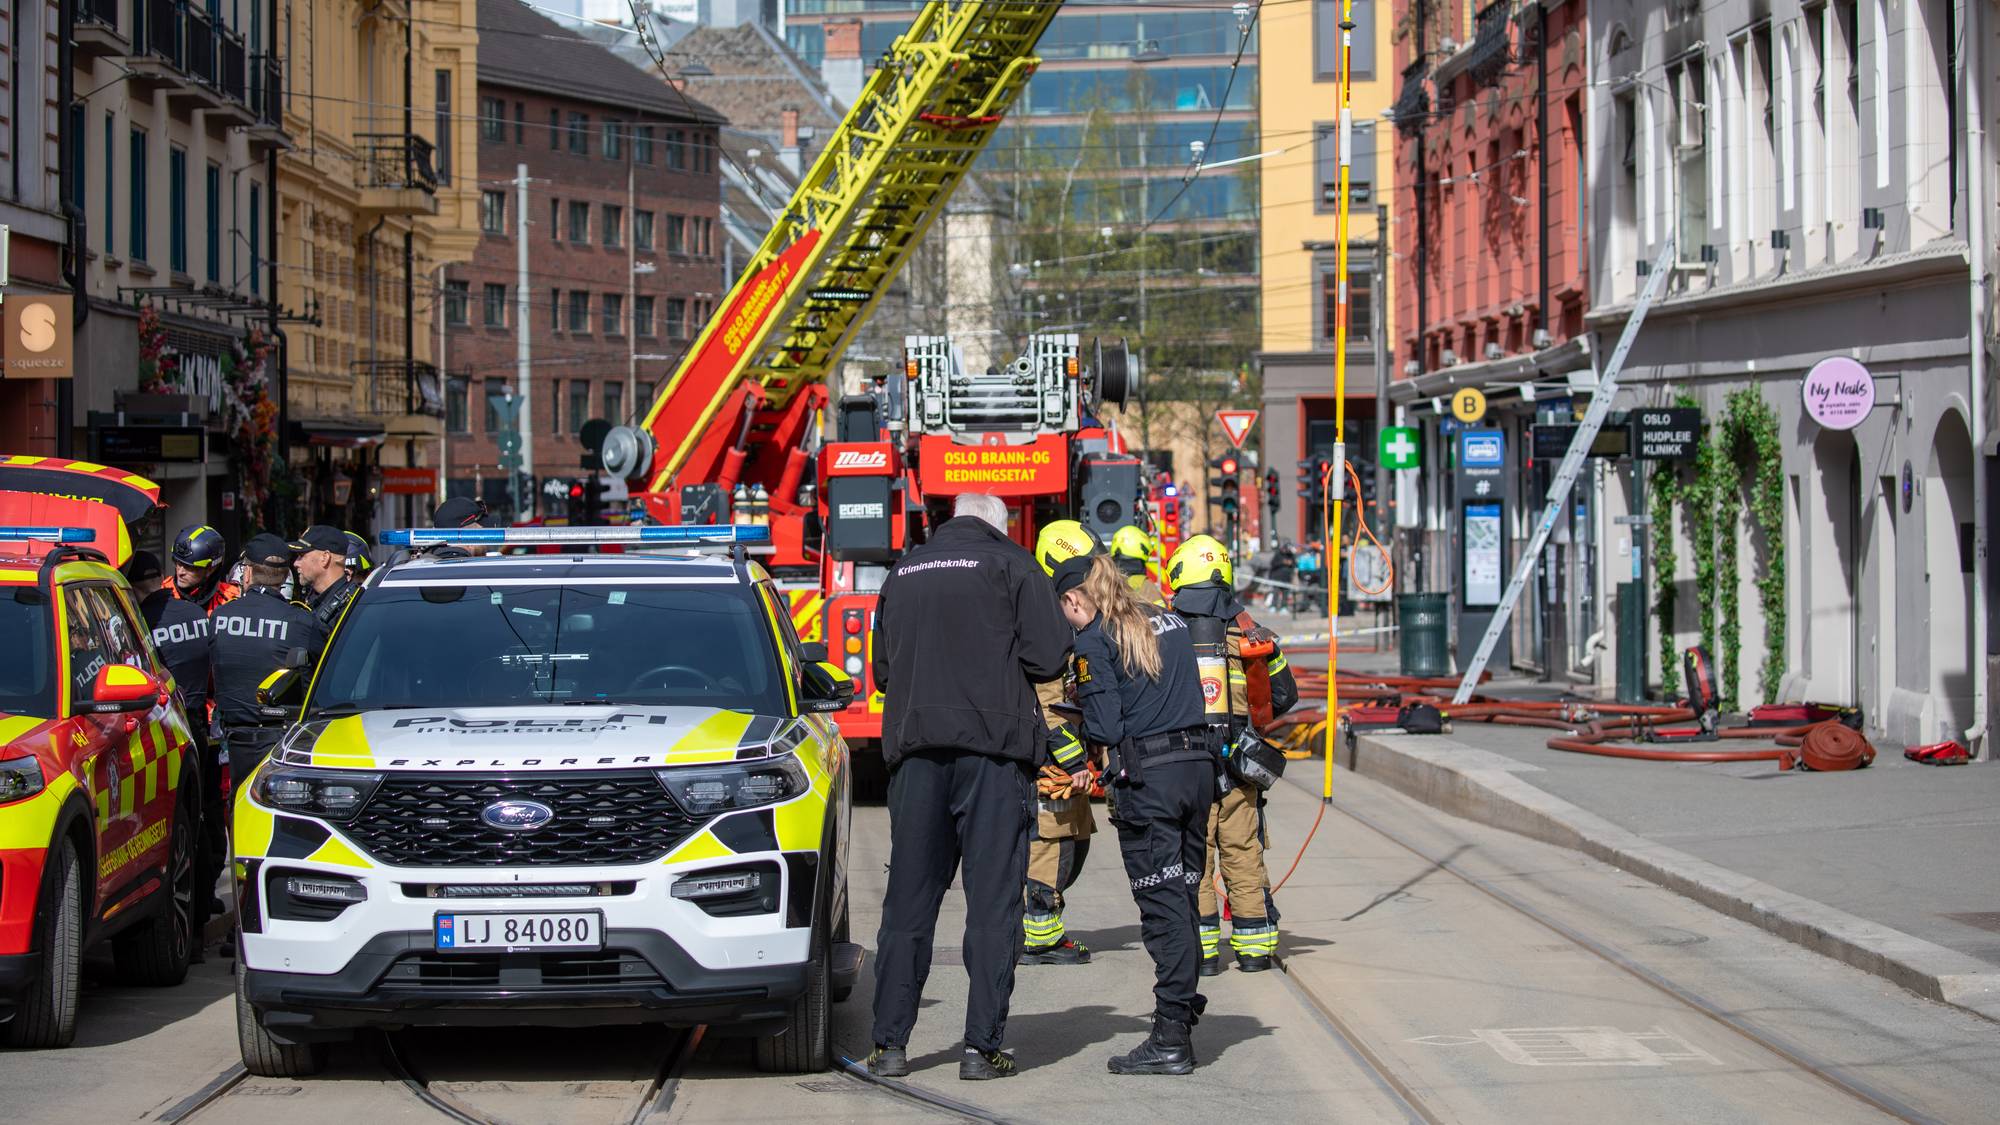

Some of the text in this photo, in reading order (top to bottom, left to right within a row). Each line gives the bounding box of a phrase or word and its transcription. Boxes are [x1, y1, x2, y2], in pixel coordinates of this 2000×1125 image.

[728, 261, 790, 355] OG REDNINGSETAT
[723, 315, 744, 347] OSLO
[11, 358, 65, 369] squeeze
[1810, 380, 1868, 402] Ny Nails
[1463, 396, 1477, 414] B
[1643, 413, 1671, 426] OSLO
[1643, 431, 1692, 443] HUDPLEIE
[1643, 444, 1682, 455] KLINIKK
[835, 451, 887, 467] Metz
[944, 452, 977, 465] OSLO
[944, 469, 1037, 482] REDNINGSETAT
[1055, 538, 1080, 557] OBRE
[897, 559, 979, 577] Kriminaltekniker
[214, 615, 288, 641] POLITI
[1148, 613, 1188, 636] OLITI
[152, 618, 210, 648] POLIT
[1078, 674, 1092, 683] OLITI
[393, 713, 667, 729] POLITI
[417, 725, 632, 734] Innsatsleder
[389, 756, 651, 766] EXPLORER
[464, 918, 589, 943] LJ 84080
[442, 935, 450, 943] N
